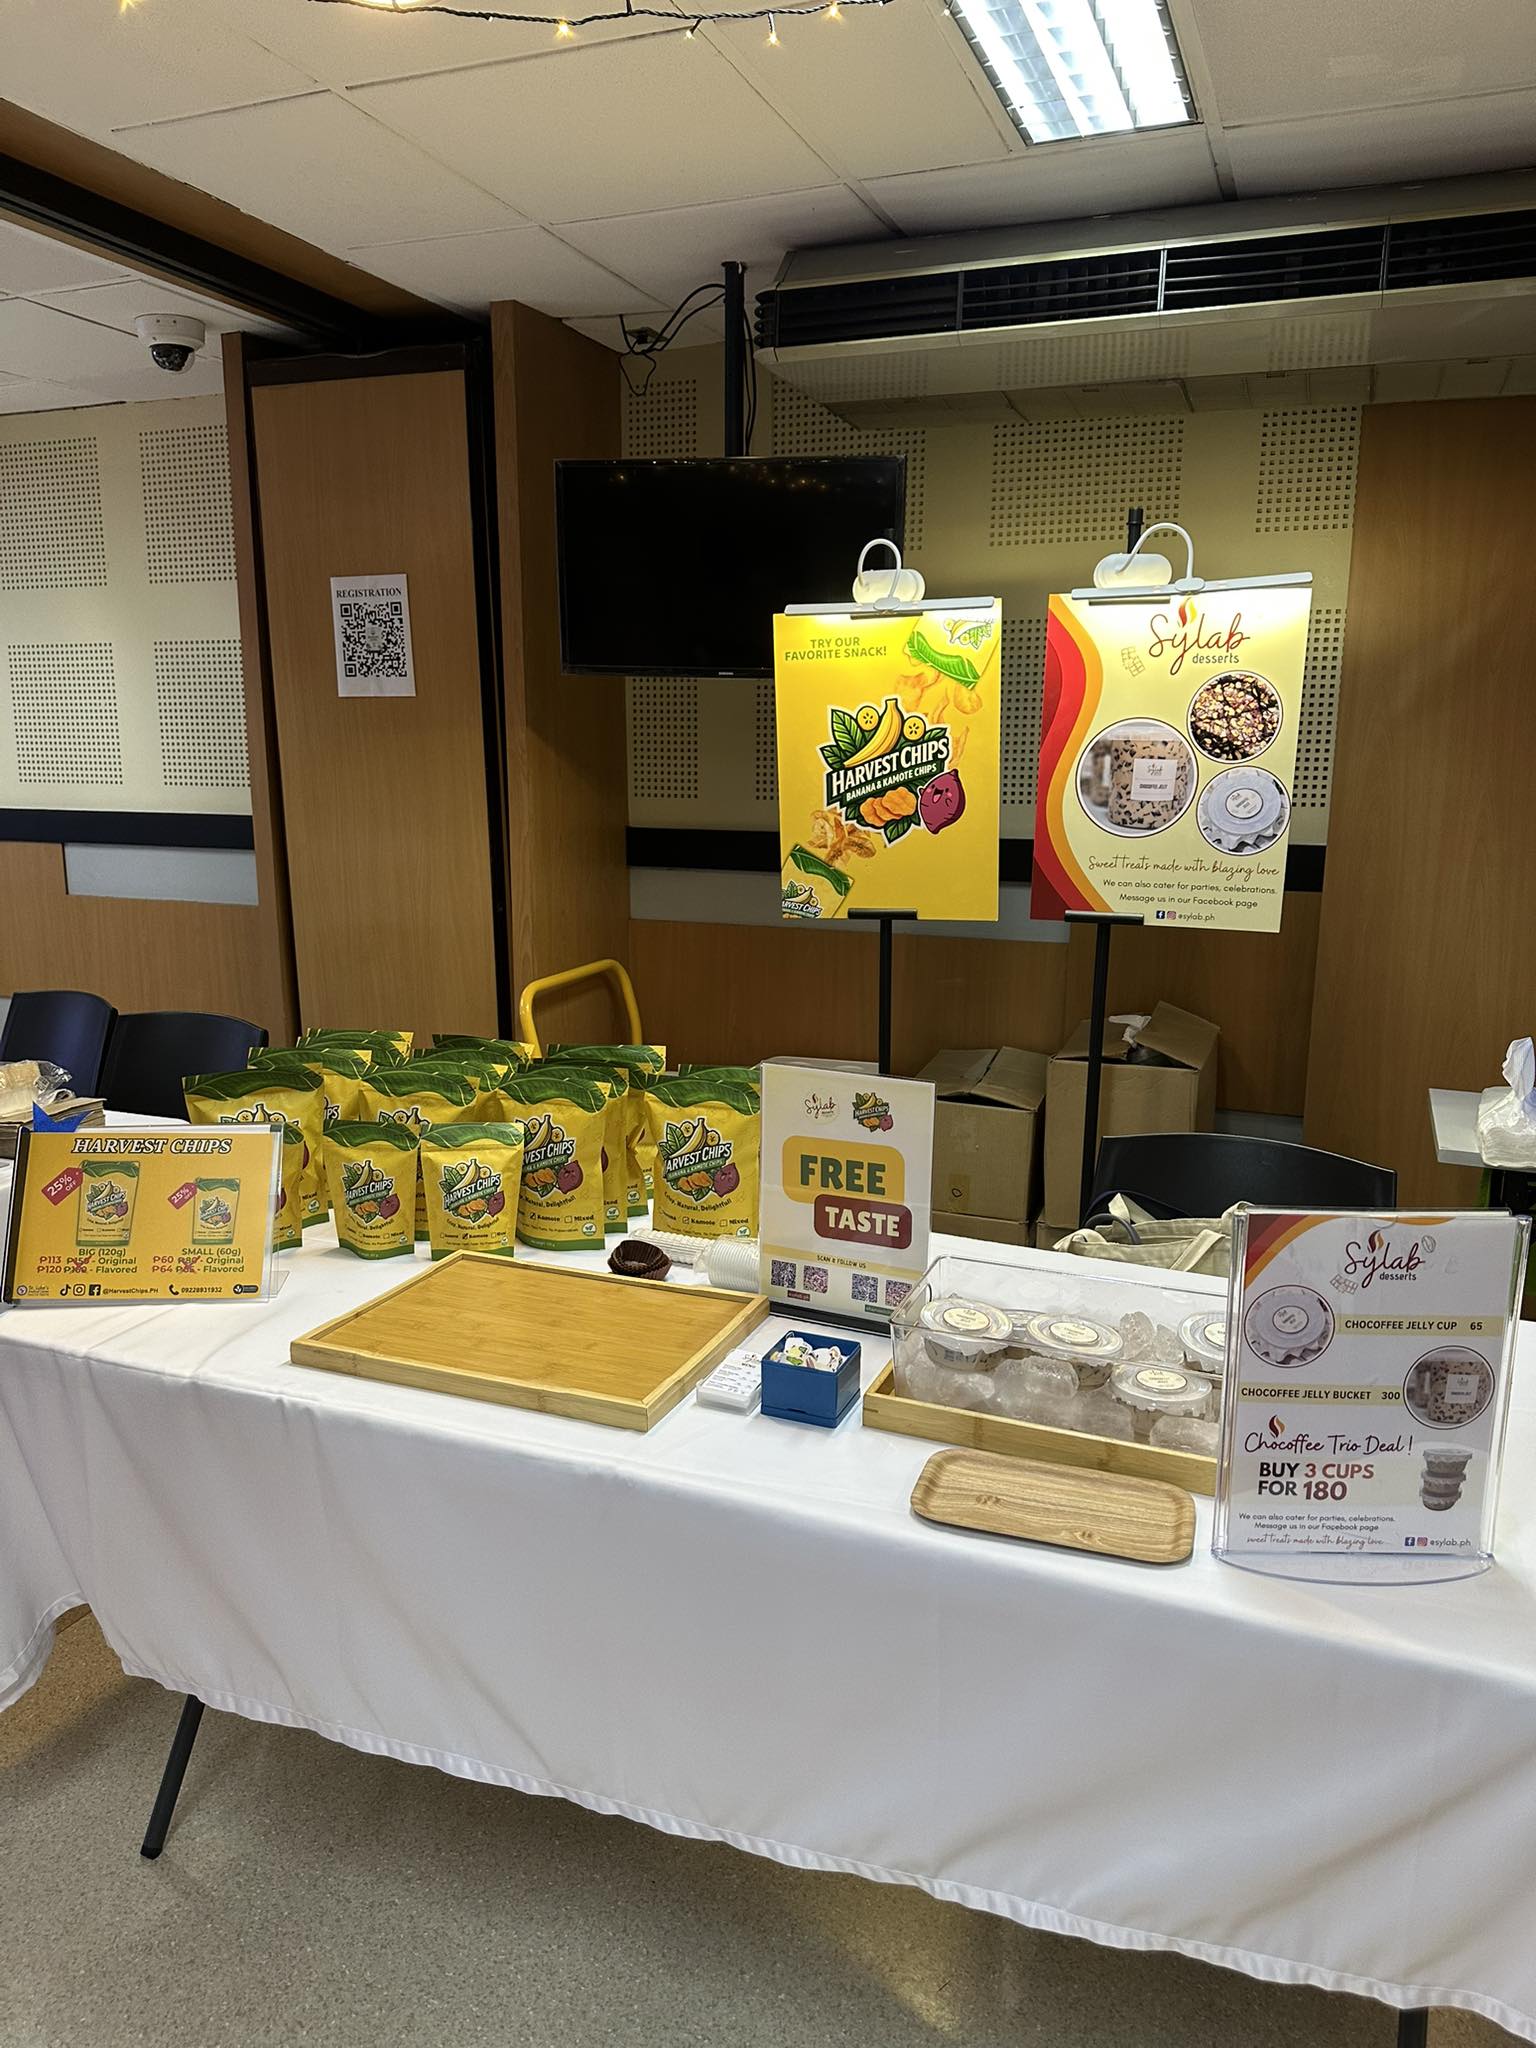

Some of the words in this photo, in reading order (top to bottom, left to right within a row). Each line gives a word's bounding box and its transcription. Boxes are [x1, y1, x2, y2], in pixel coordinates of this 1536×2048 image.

[336, 588, 402, 598] REGISTRATION
[810, 639, 832, 648] TRY
[835, 637, 860, 647] OUR
[1149, 613, 1250, 675] Sylab
[785, 649, 840, 661] FAVORITE
[844, 646, 887, 658] SNACK!
[1192, 653, 1239, 664] desserts
[831, 752, 899, 797] HARVEST
[900, 738, 949, 768] CHIPS
[846, 781, 876, 801] BANANA
[876, 781, 881, 789] &
[883, 772, 913, 787] KAMOTE
[914, 763, 937, 776] CHIPS
[1088, 855, 1118, 870] Sweet
[1153, 859, 1182, 872] made
[1184, 858, 1209, 872] with
[1211, 860, 1254, 881] blazing
[1257, 862, 1280, 876] love
[1134, 880, 1151, 888] also
[1177, 881, 1189, 889] for
[1190, 883, 1221, 892] parties,
[1224, 885, 1277, 894] celebrations.
[1119, 893, 1155, 904] Message
[1193, 896, 1234, 906] Facebook
[1235, 900, 1258, 908] page
[804, 1096, 836, 1119] Sylab
[72, 1138, 167, 1154] HARVEST
[171, 1138, 232, 1154] CHIPS
[547, 1141, 573, 1157] CHIPS
[702, 1145, 730, 1161] CHIPS
[800, 1154, 886, 1195] FREE
[47, 1175, 72, 1196] 25%
[65, 1181, 77, 1191] OFF
[369, 1179, 393, 1193] CHIPS
[476, 1176, 500, 1190] CHIPS
[171, 1187, 189, 1203] 25%
[825, 1206, 899, 1237] TASTE
[78, 1248, 96, 1256] BIG
[98, 1248, 126, 1256] (120g)
[181, 1248, 214, 1256] SMALL
[216, 1247, 241, 1256] (60g)
[98, 1257, 137, 1266] Original
[206, 1256, 244, 1265] Original
[816, 1254, 831, 1263] SCAN
[836, 1258, 857, 1267] FOLLOW
[1344, 1241, 1426, 1288] Sylab
[96, 1265, 137, 1273] Flavored
[203, 1265, 244, 1273] Flavored
[1379, 1272, 1417, 1280] desserts
[102, 1287, 158, 1295] @HarvestChips.PH
[1345, 1320, 1404, 1329] CHOCOFFEE
[1405, 1321, 1434, 1330] JELLY
[1436, 1321, 1457, 1330] CUP
[1470, 1322, 1483, 1330] 65
[1241, 1388, 1300, 1398] CHOCOFFEE
[1302, 1389, 1330, 1398] JELLY
[1333, 1390, 1371, 1400] BUCKET
[1382, 1391, 1400, 1400] 300
[1244, 1432, 1325, 1454] Chocoffee
[1327, 1434, 1361, 1455] Trio
[1363, 1435, 1405, 1455] Deal
[1259, 1462, 1300, 1477] BUY
[1304, 1463, 1316, 1478] 3
[1322, 1463, 1374, 1479] CUPS
[1258, 1480, 1297, 1496] FOR
[1303, 1481, 1347, 1500] 180
[1319, 1515, 1347, 1523] parties,
[1254, 1522, 1287, 1531] Message
[1269, 1534, 1291, 1544] treats
[1293, 1536, 1314, 1544] made
[1316, 1534, 1334, 1545] with
[1336, 1535, 1366, 1549] blazing
[1367, 1537, 1385, 1545] love
